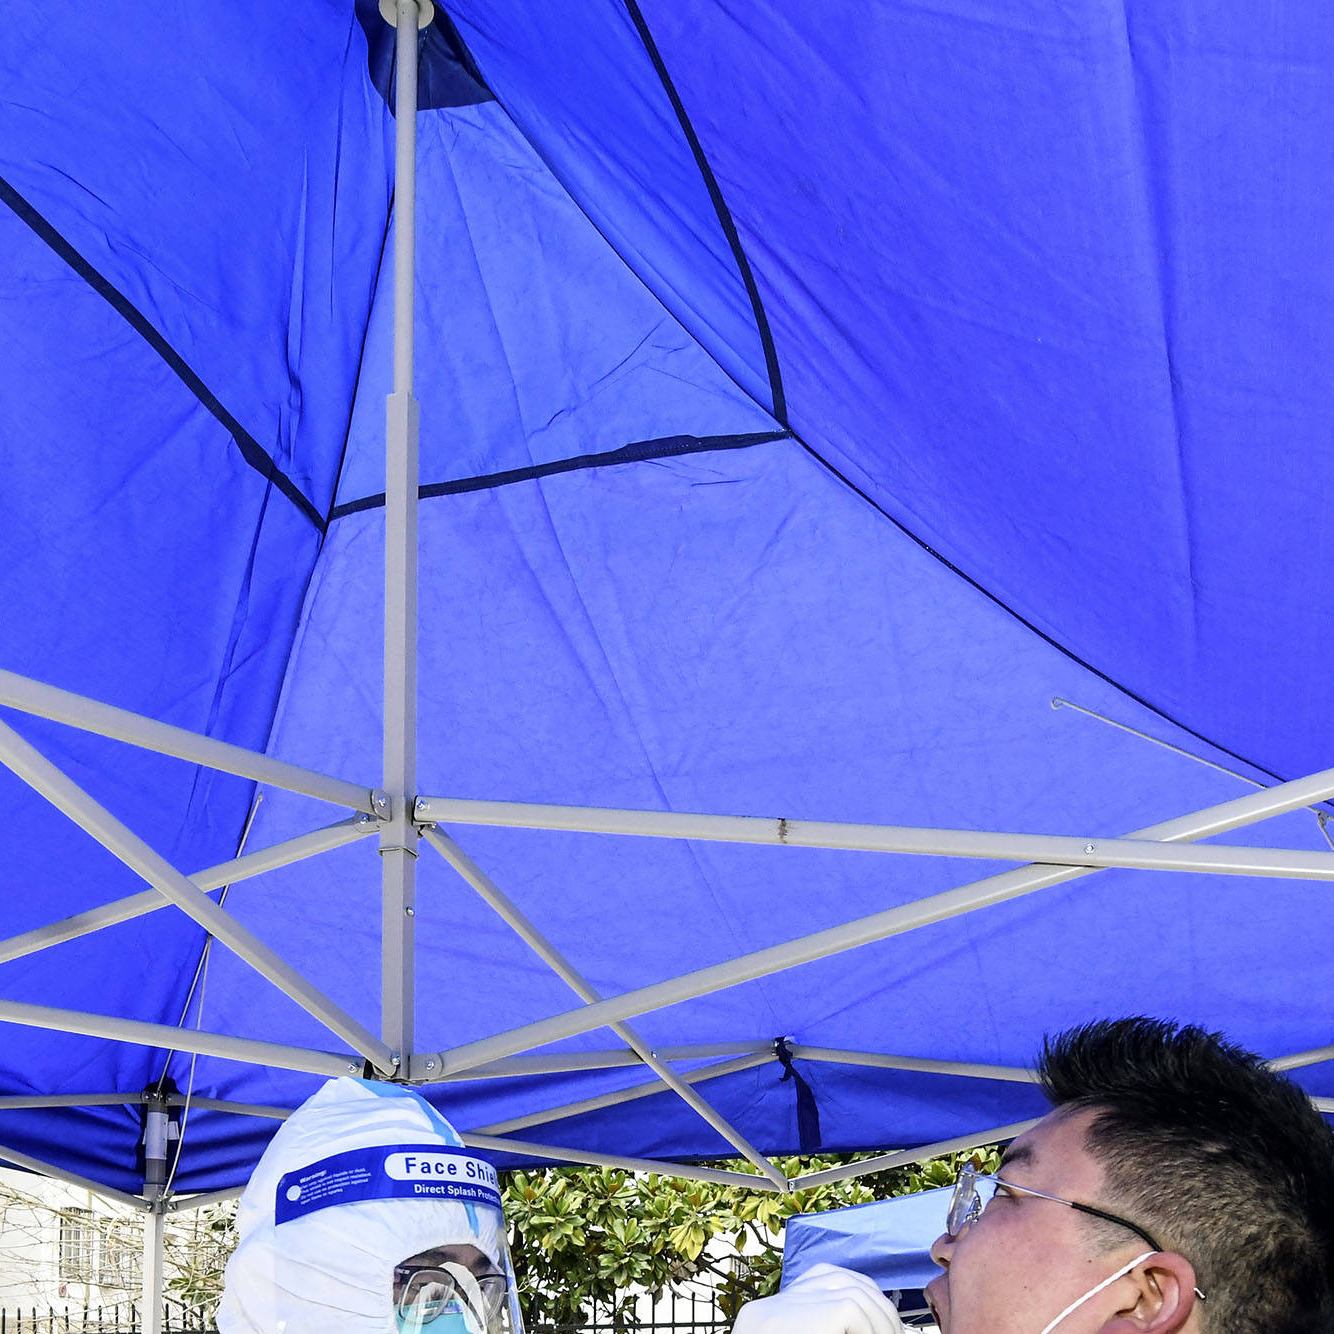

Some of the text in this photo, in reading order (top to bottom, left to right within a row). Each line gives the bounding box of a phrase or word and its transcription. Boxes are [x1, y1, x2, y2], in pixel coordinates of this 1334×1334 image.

[405, 1157, 457, 1175] Face
[414, 1183, 445, 1194] Direct
[447, 1185, 476, 1197] Splash
